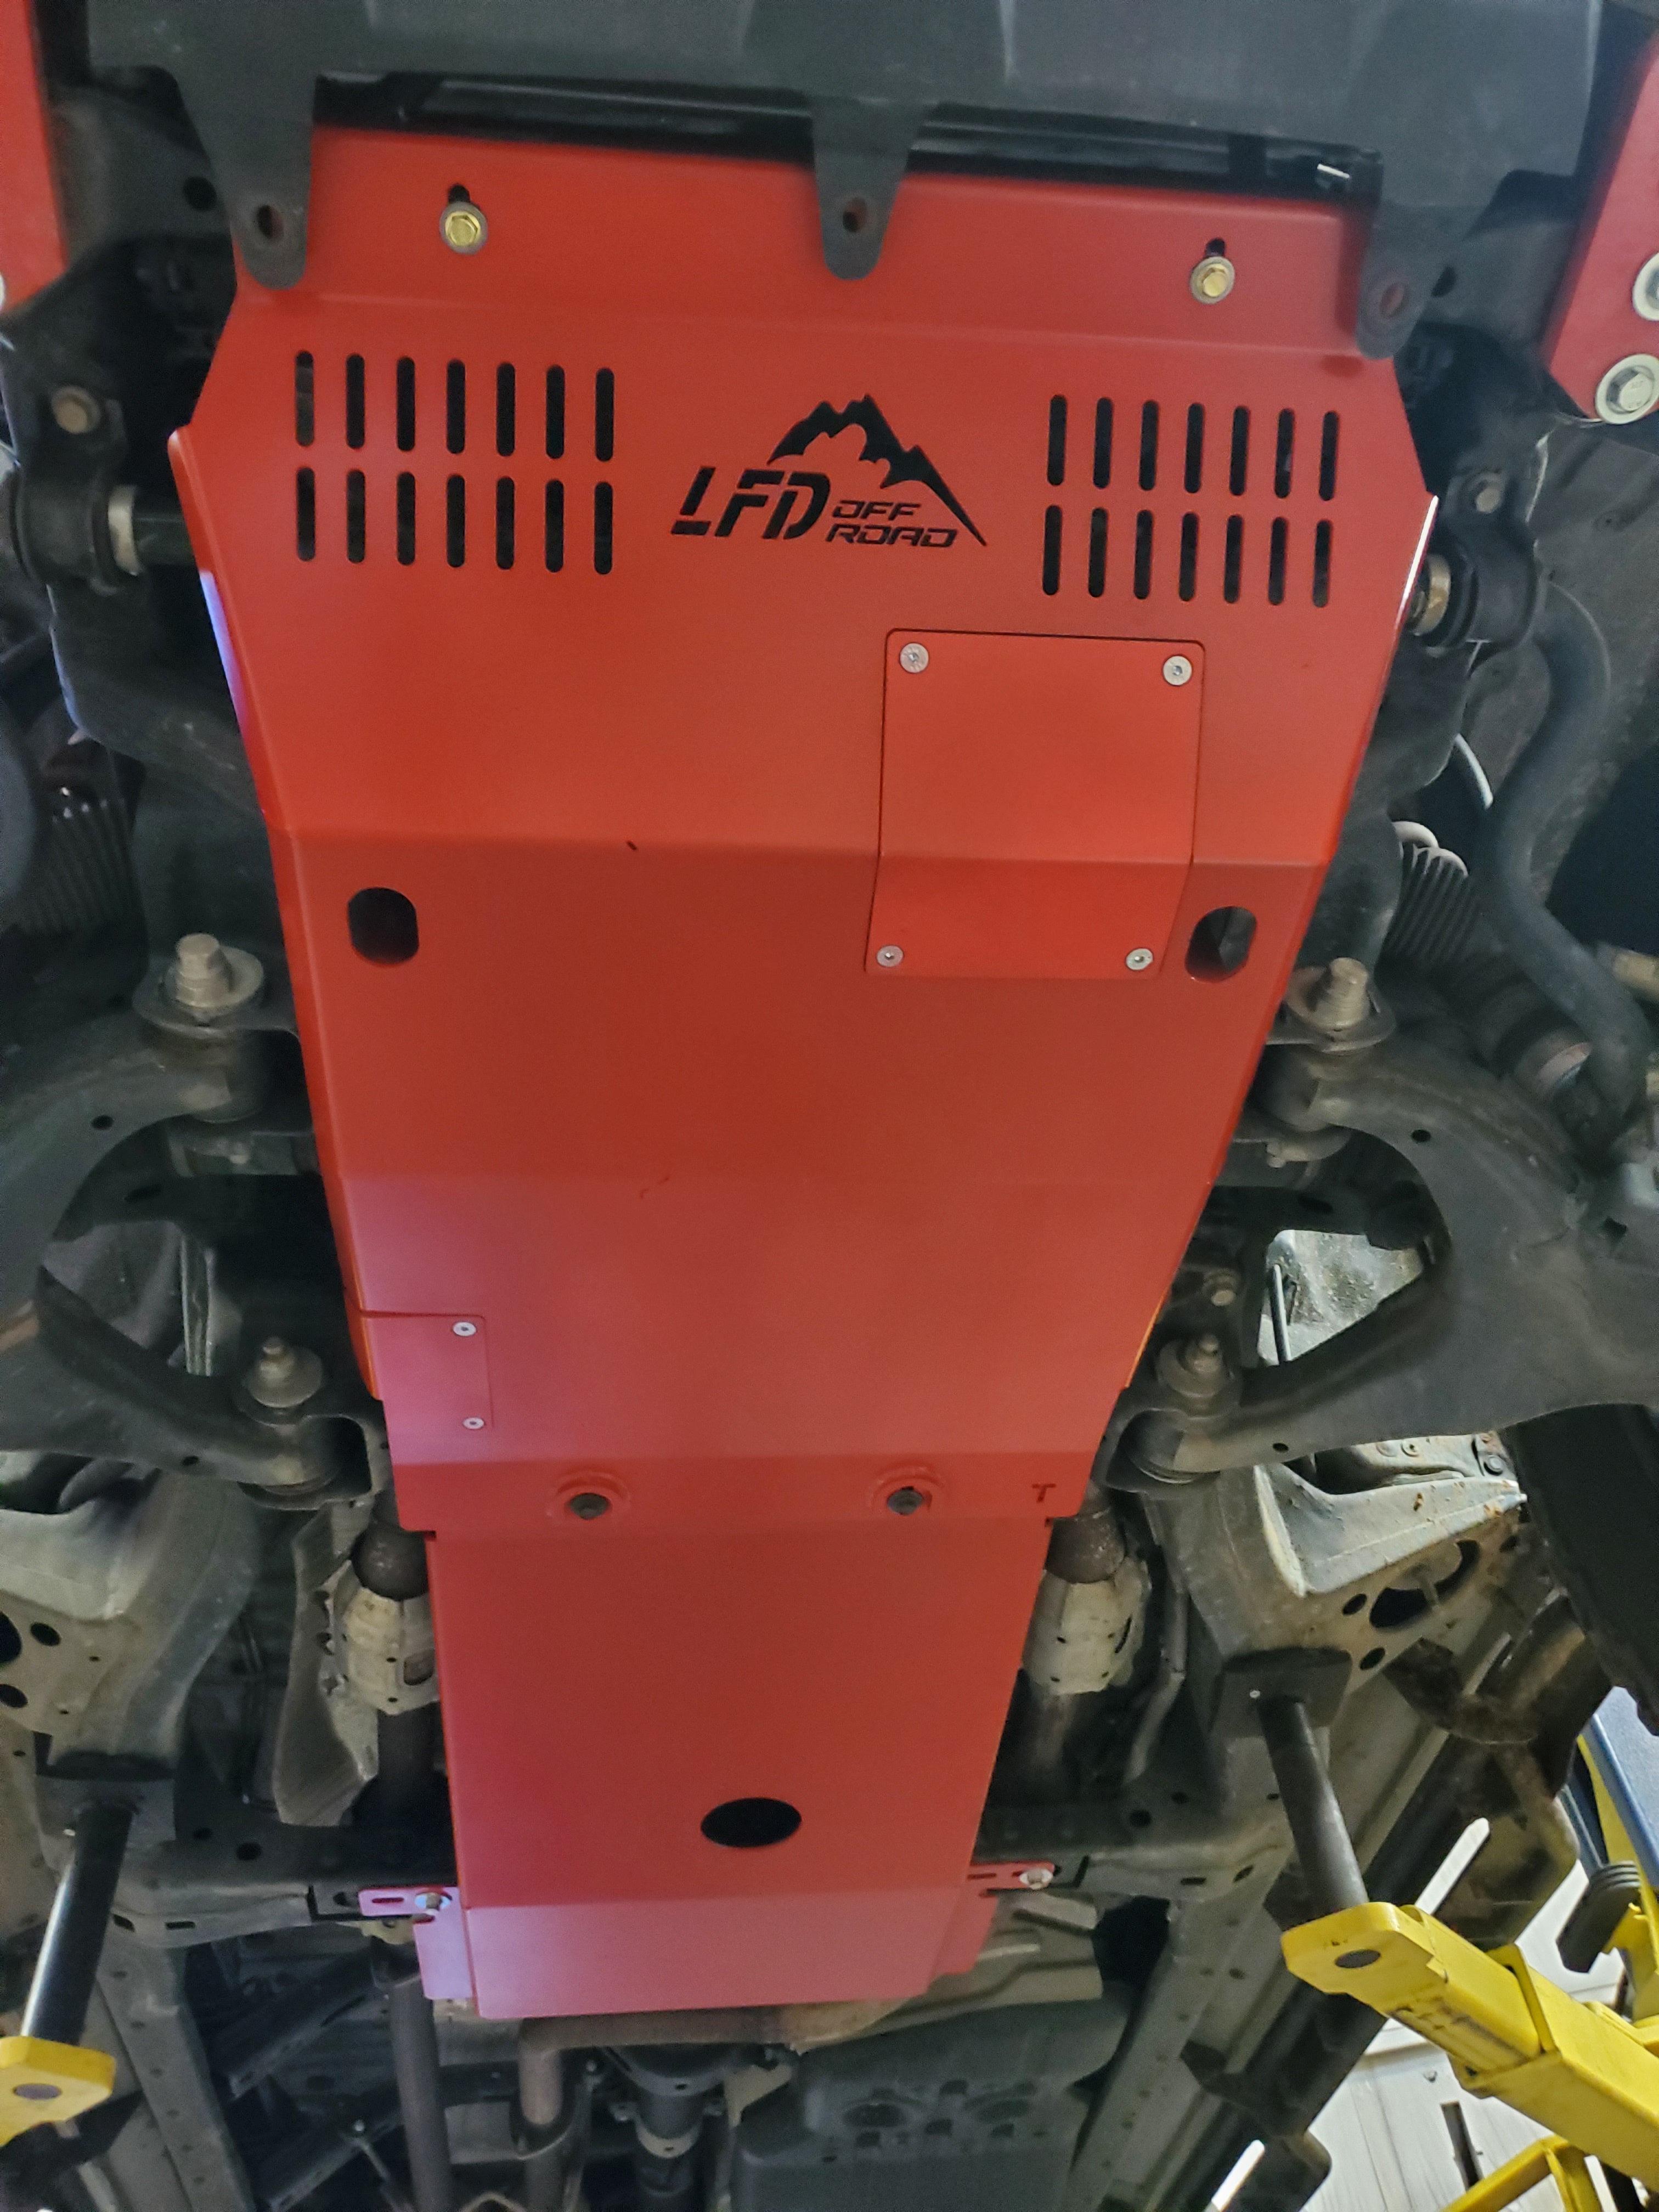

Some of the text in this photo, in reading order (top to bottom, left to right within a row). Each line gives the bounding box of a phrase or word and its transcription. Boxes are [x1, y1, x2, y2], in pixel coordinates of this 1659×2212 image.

[670, 466, 831, 540] LFD
[832, 499, 921, 521] OFF
[825, 523, 958, 548] ROAD
